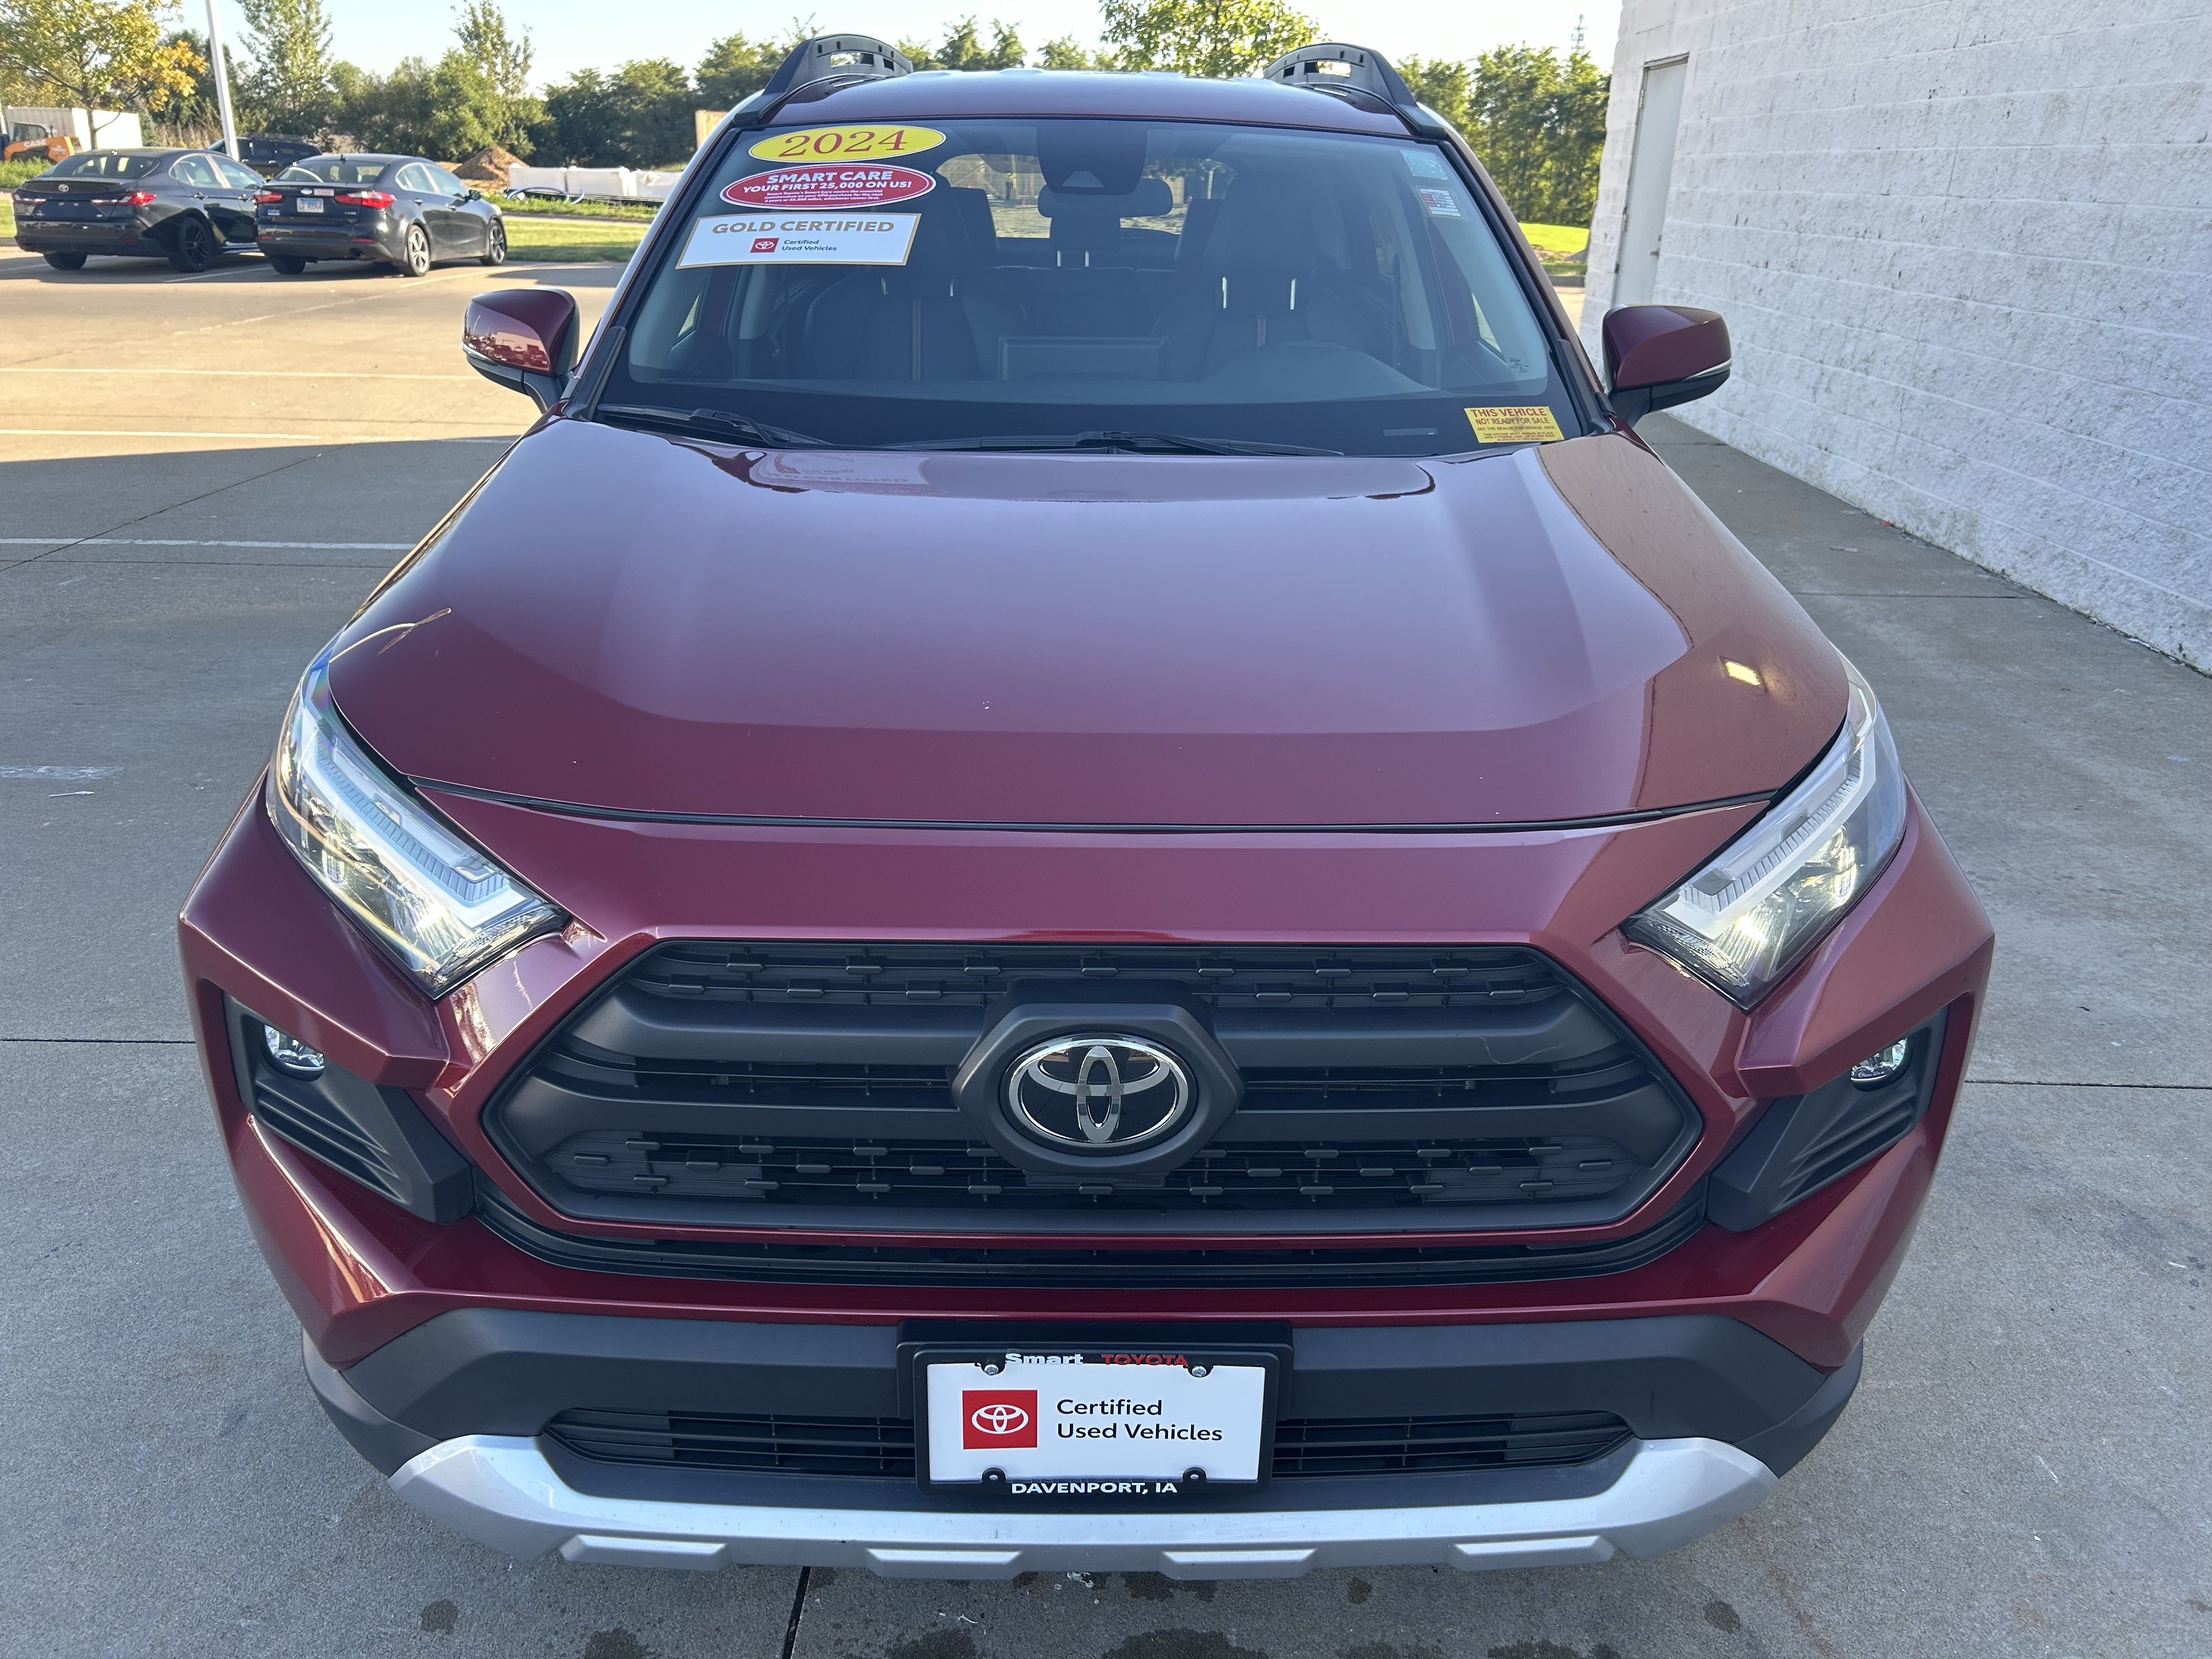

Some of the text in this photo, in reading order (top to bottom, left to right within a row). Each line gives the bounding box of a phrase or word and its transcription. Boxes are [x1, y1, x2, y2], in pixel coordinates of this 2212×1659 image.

[24, 139, 47, 148] CASE
[778, 130, 908, 158] 2024
[766, 171, 893, 184] SMART CARE
[743, 184, 780, 193] YOUR
[781, 183, 819, 191] FIRST
[819, 182, 864, 190] 25,000
[712, 221, 895, 234] GOLD CERTIFIED
[1470, 408, 1547, 417] THIS VEHICLE
[1006, 1353, 1189, 1367] Smart TOYOTA
[1057, 1398, 1163, 1416] Certified
[1057, 1423, 1223, 1441] Used Vehicles
[1012, 1482, 1178, 1494] DAVENPORT, IA
